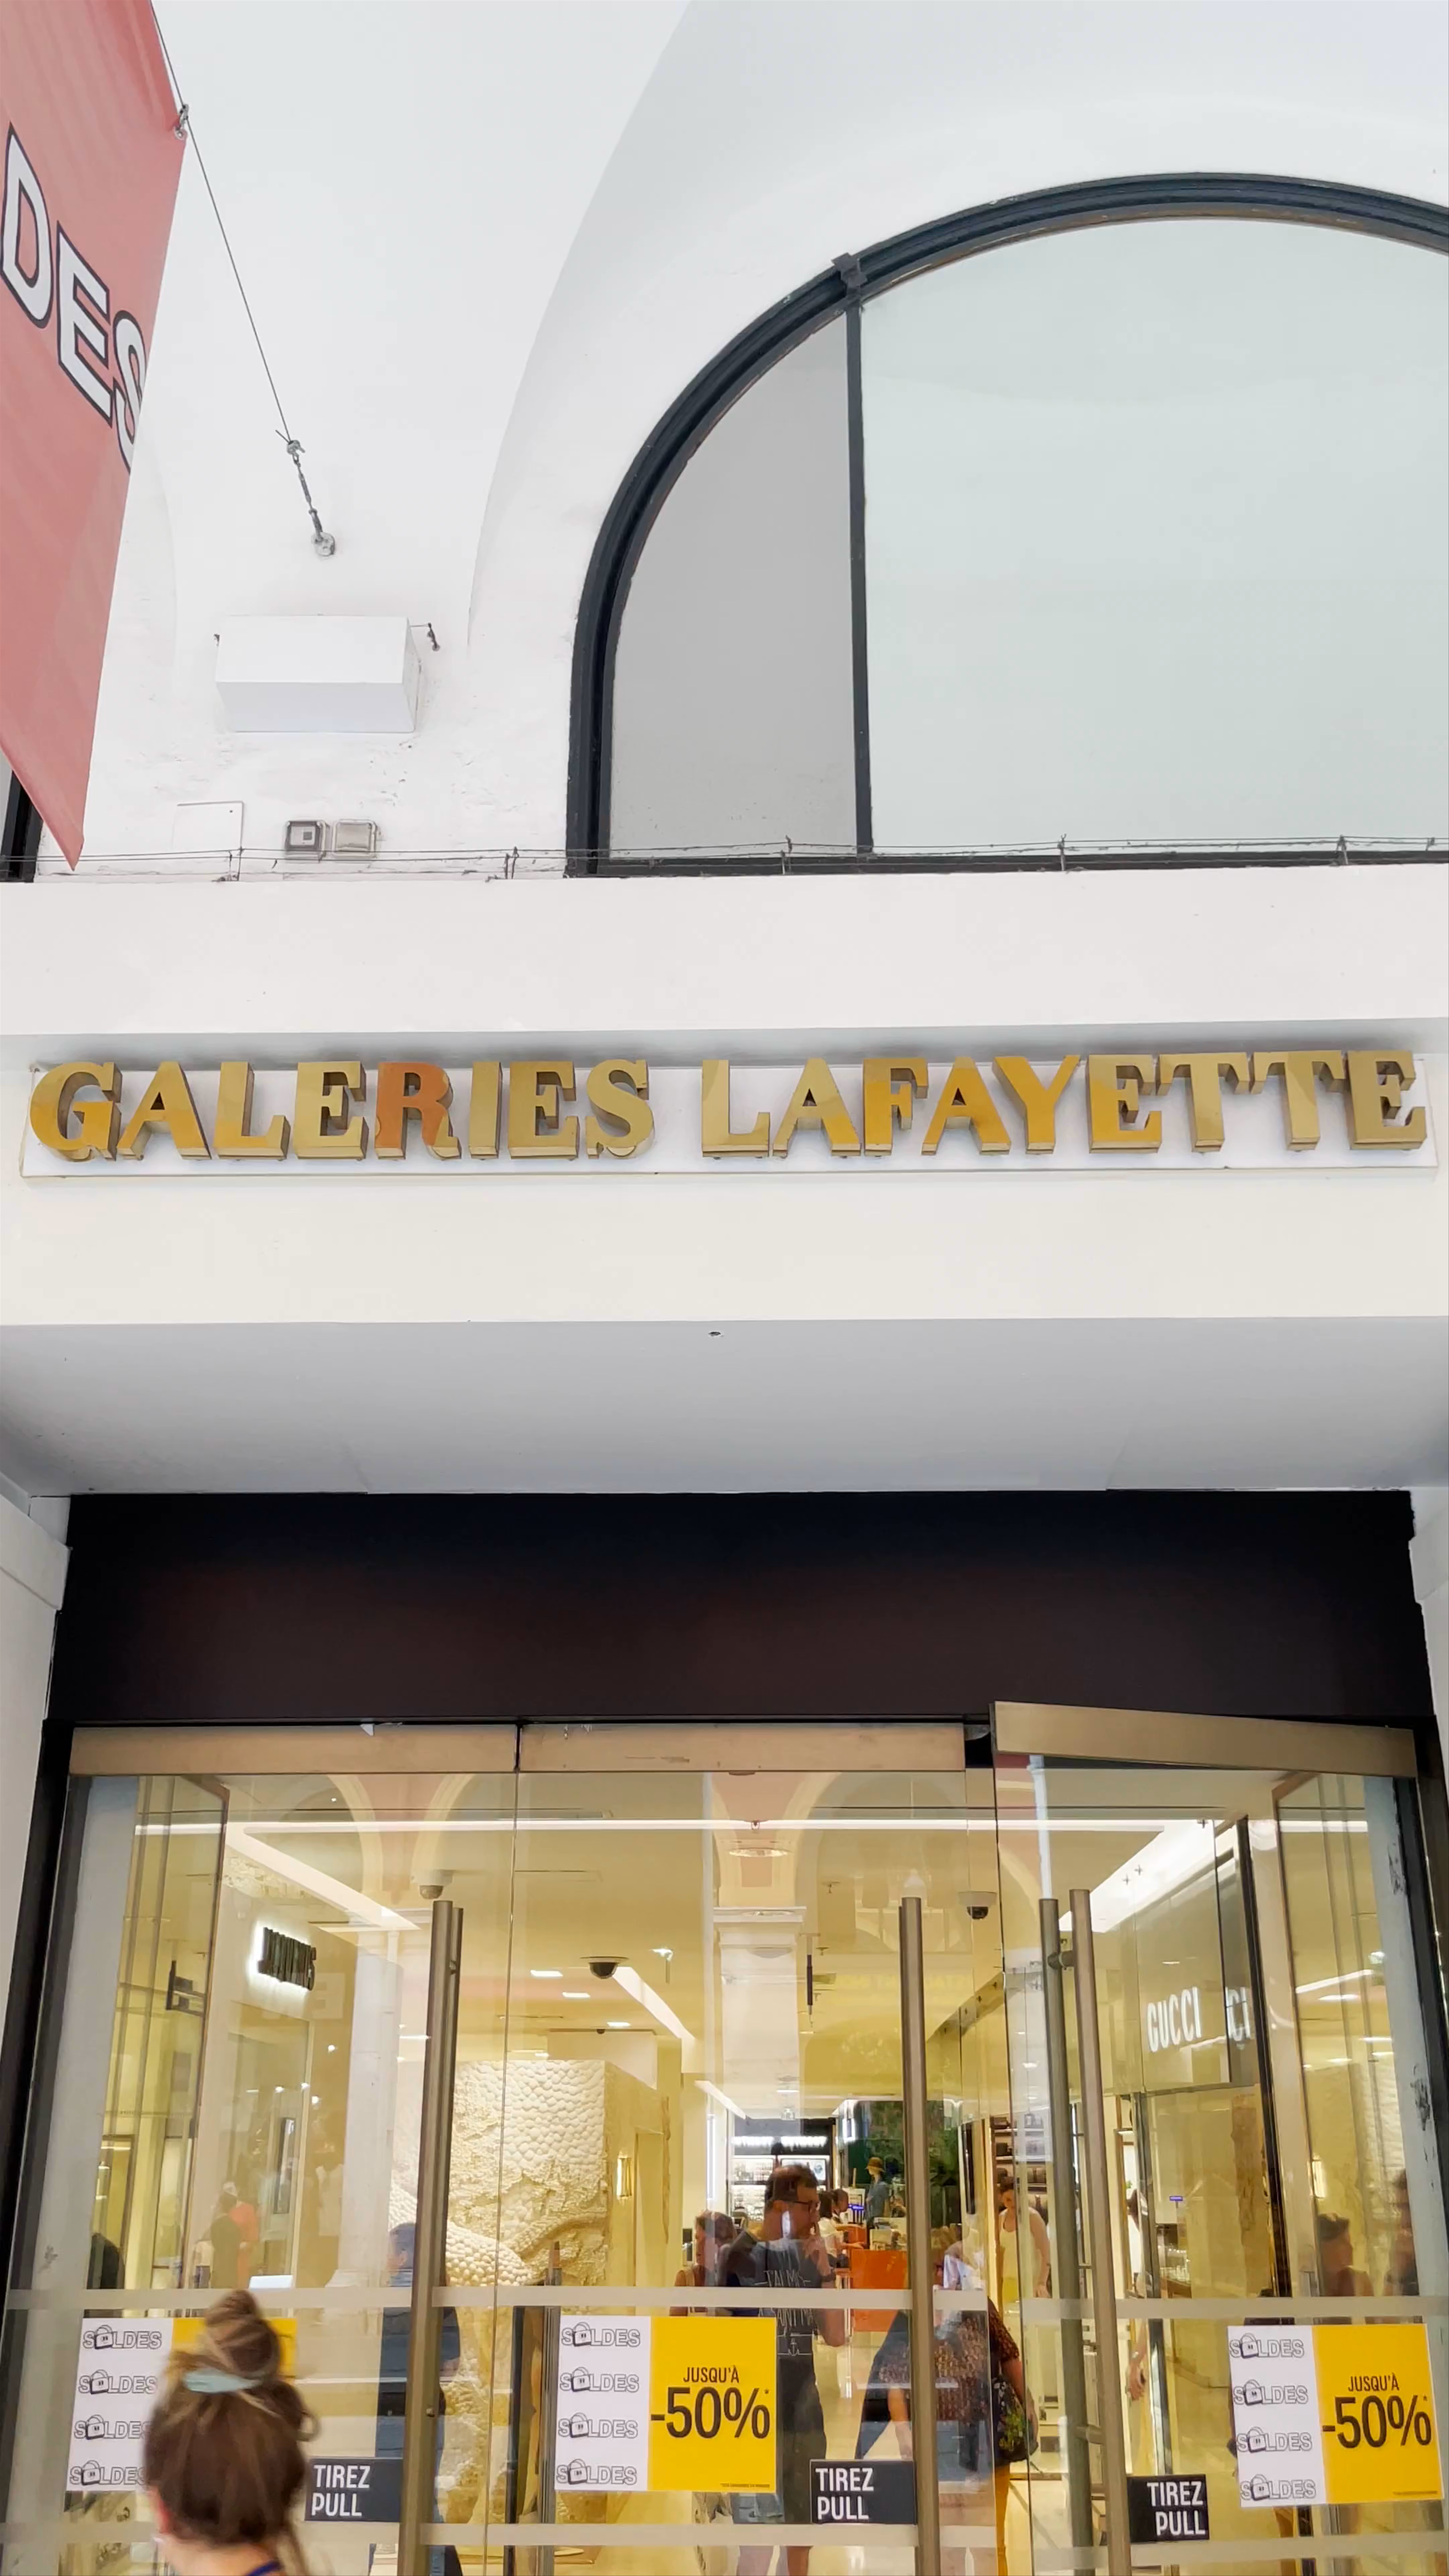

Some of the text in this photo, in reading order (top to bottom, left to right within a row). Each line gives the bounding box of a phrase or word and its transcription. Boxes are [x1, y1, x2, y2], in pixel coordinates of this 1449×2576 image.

[30, 1049, 1428, 1161] GALERIES LAFAYETTE
[1147, 1987, 1202, 2052] GUCCI
[683, 2365, 739, 2383] JUSQU'À
[1348, 2373, 1400, 2392] JUSQU'À
[314, 2464, 371, 2489] TIREZ
[815, 2468, 874, 2491] TIREZ
[311, 2493, 362, 2517] PULL
[1147, 2481, 1204, 2506] TIREZ
[818, 2496, 869, 2520] PULL
[1155, 2510, 1206, 2536] PULL
